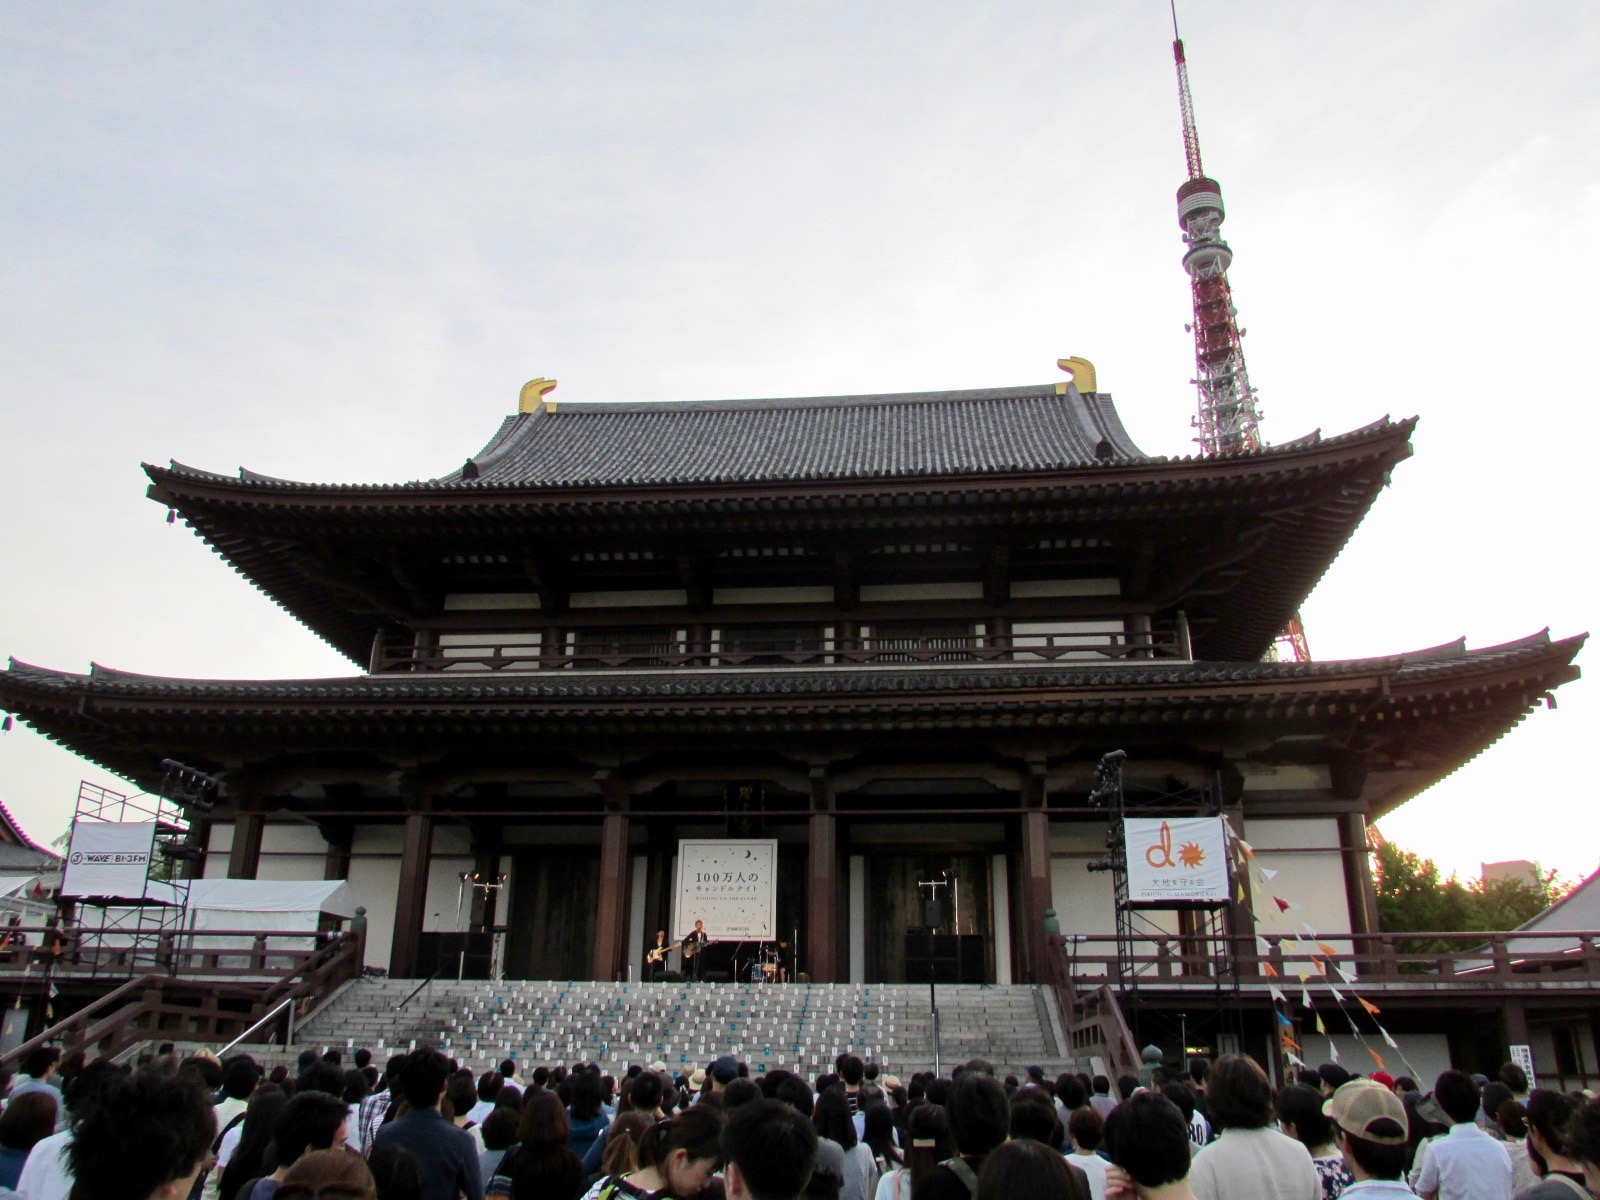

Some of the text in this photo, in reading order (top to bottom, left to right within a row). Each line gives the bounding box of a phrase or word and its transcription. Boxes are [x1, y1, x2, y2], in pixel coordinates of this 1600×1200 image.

[696, 872, 759, 883] 100万人の
[1151, 878, 1205, 887] 大地を守る会
[696, 885, 758, 893] キャンドルナイト
